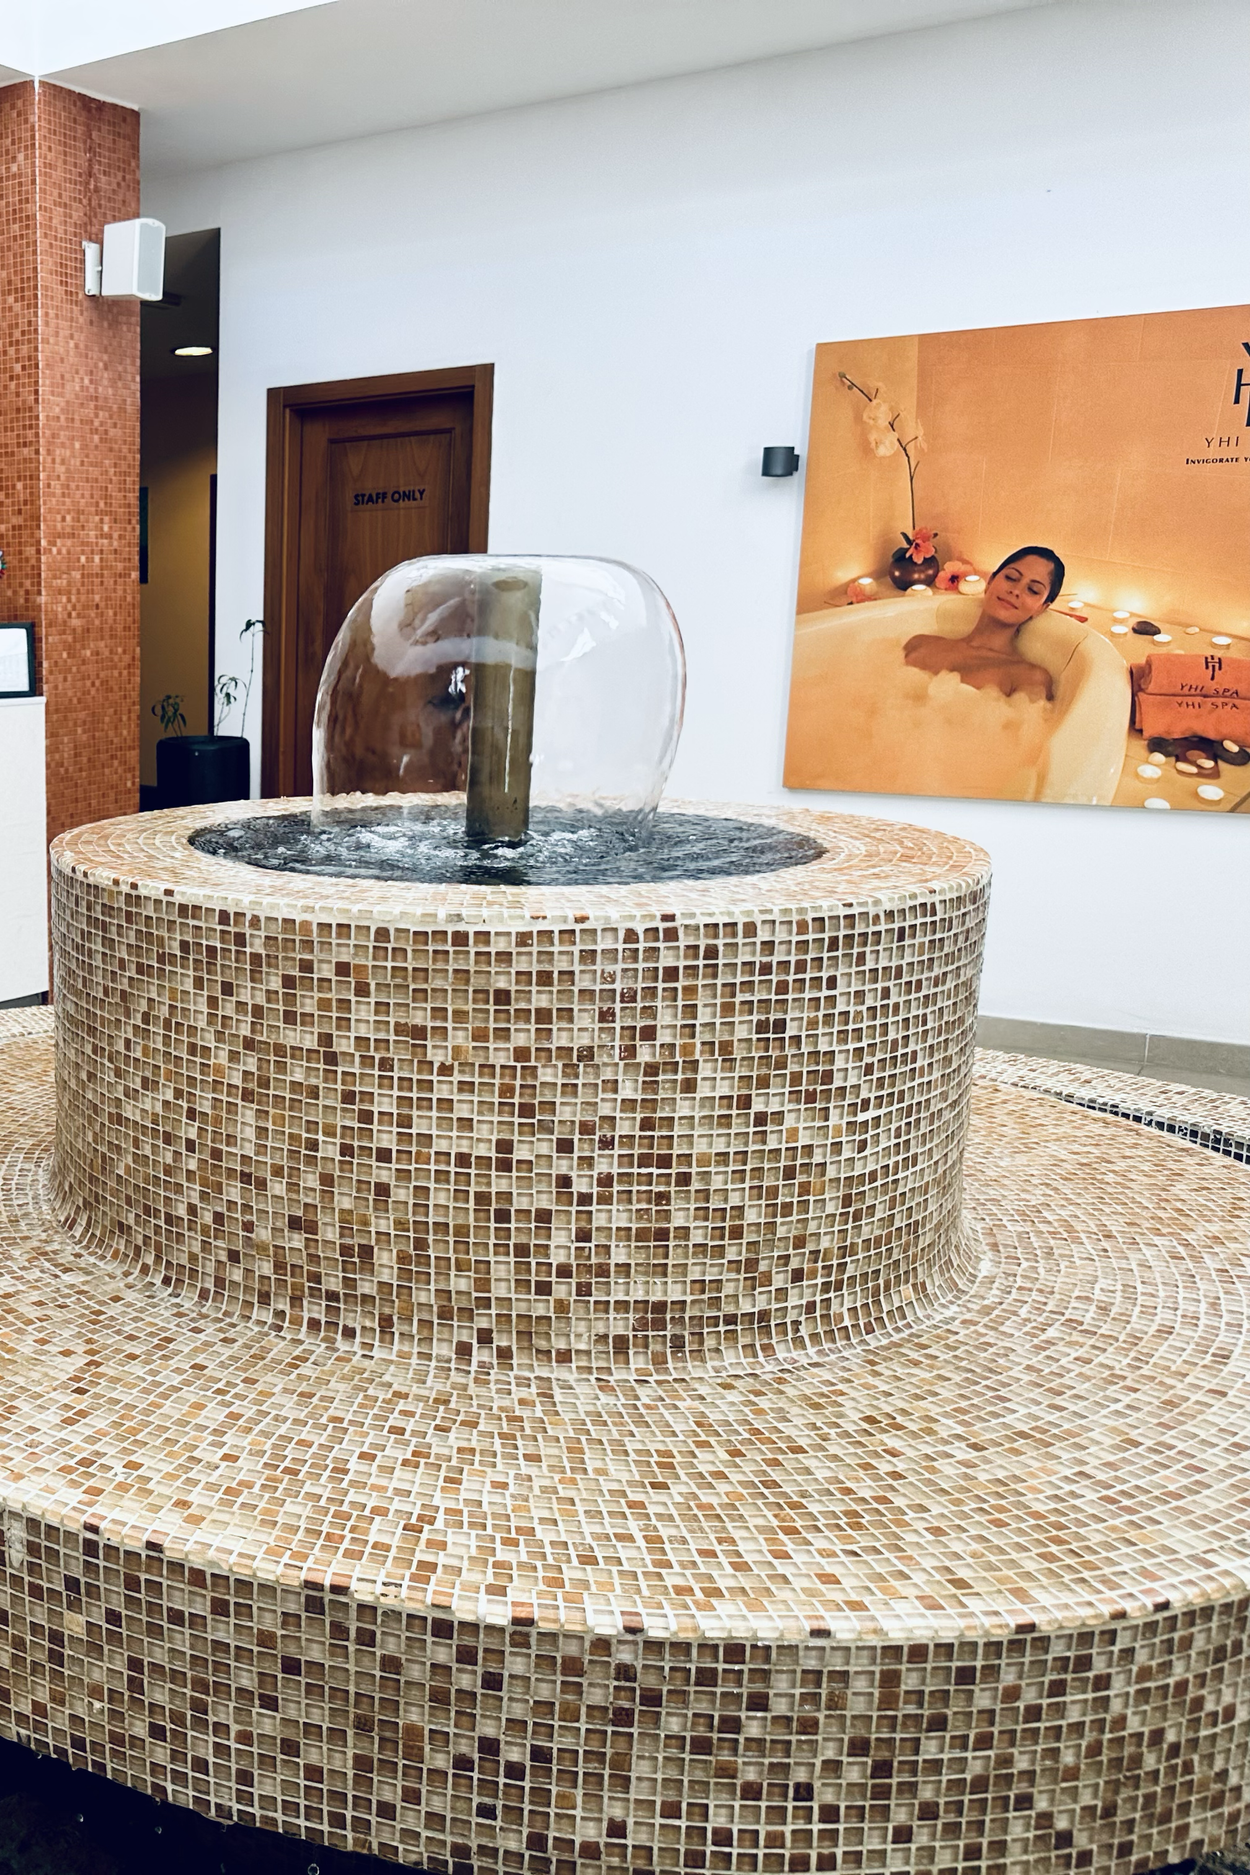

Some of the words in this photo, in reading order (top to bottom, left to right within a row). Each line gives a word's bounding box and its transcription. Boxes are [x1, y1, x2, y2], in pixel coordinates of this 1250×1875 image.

[1205, 436, 1239, 448] YHI
[1185, 457, 1240, 465] INVIGORATE
[353, 492, 388, 506] STAFF
[390, 488, 426, 503] ONLY
[1179, 682, 1205, 693] YHI
[1212, 687, 1239, 697] SPA
[1176, 700, 1201, 709] YHI
[1210, 701, 1239, 710] SPA
